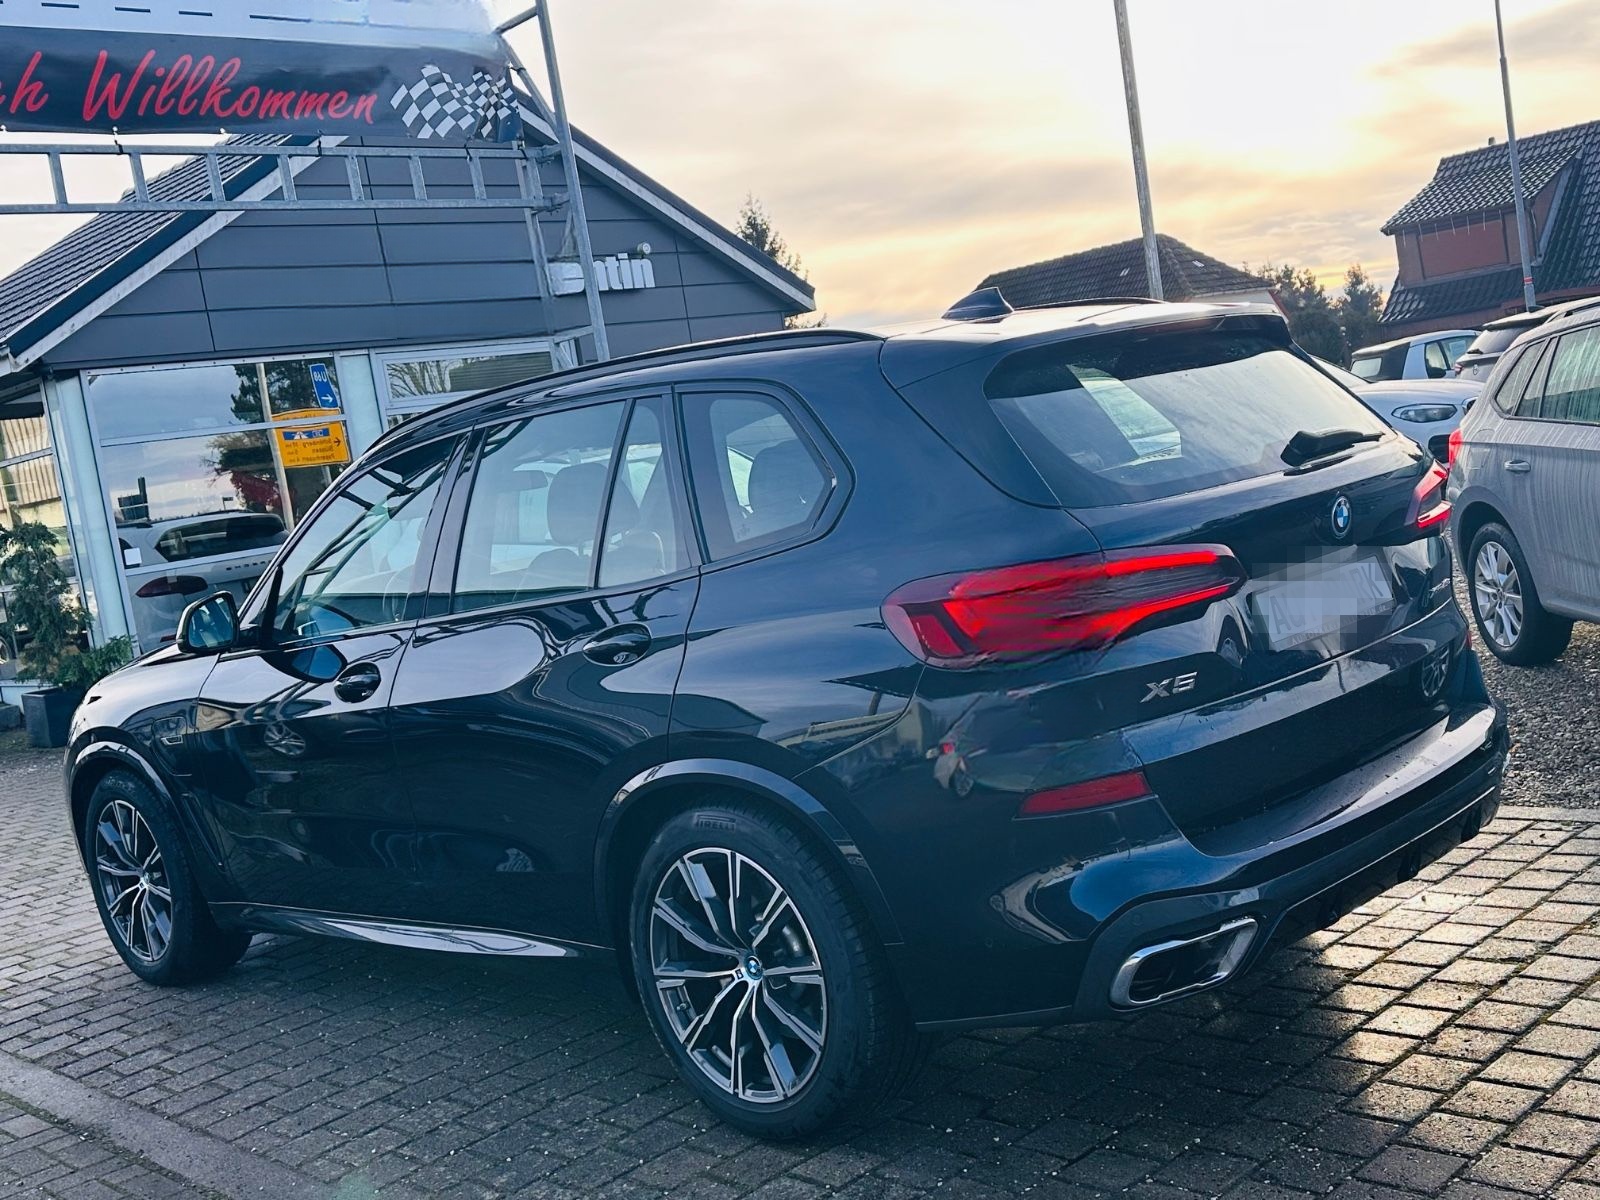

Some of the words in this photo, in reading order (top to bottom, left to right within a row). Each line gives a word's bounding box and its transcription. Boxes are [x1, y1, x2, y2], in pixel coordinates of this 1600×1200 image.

[0, 50, 49, 114] h
[82, 49, 378, 124] Willkommen
[1140, 671, 1198, 703] X5
